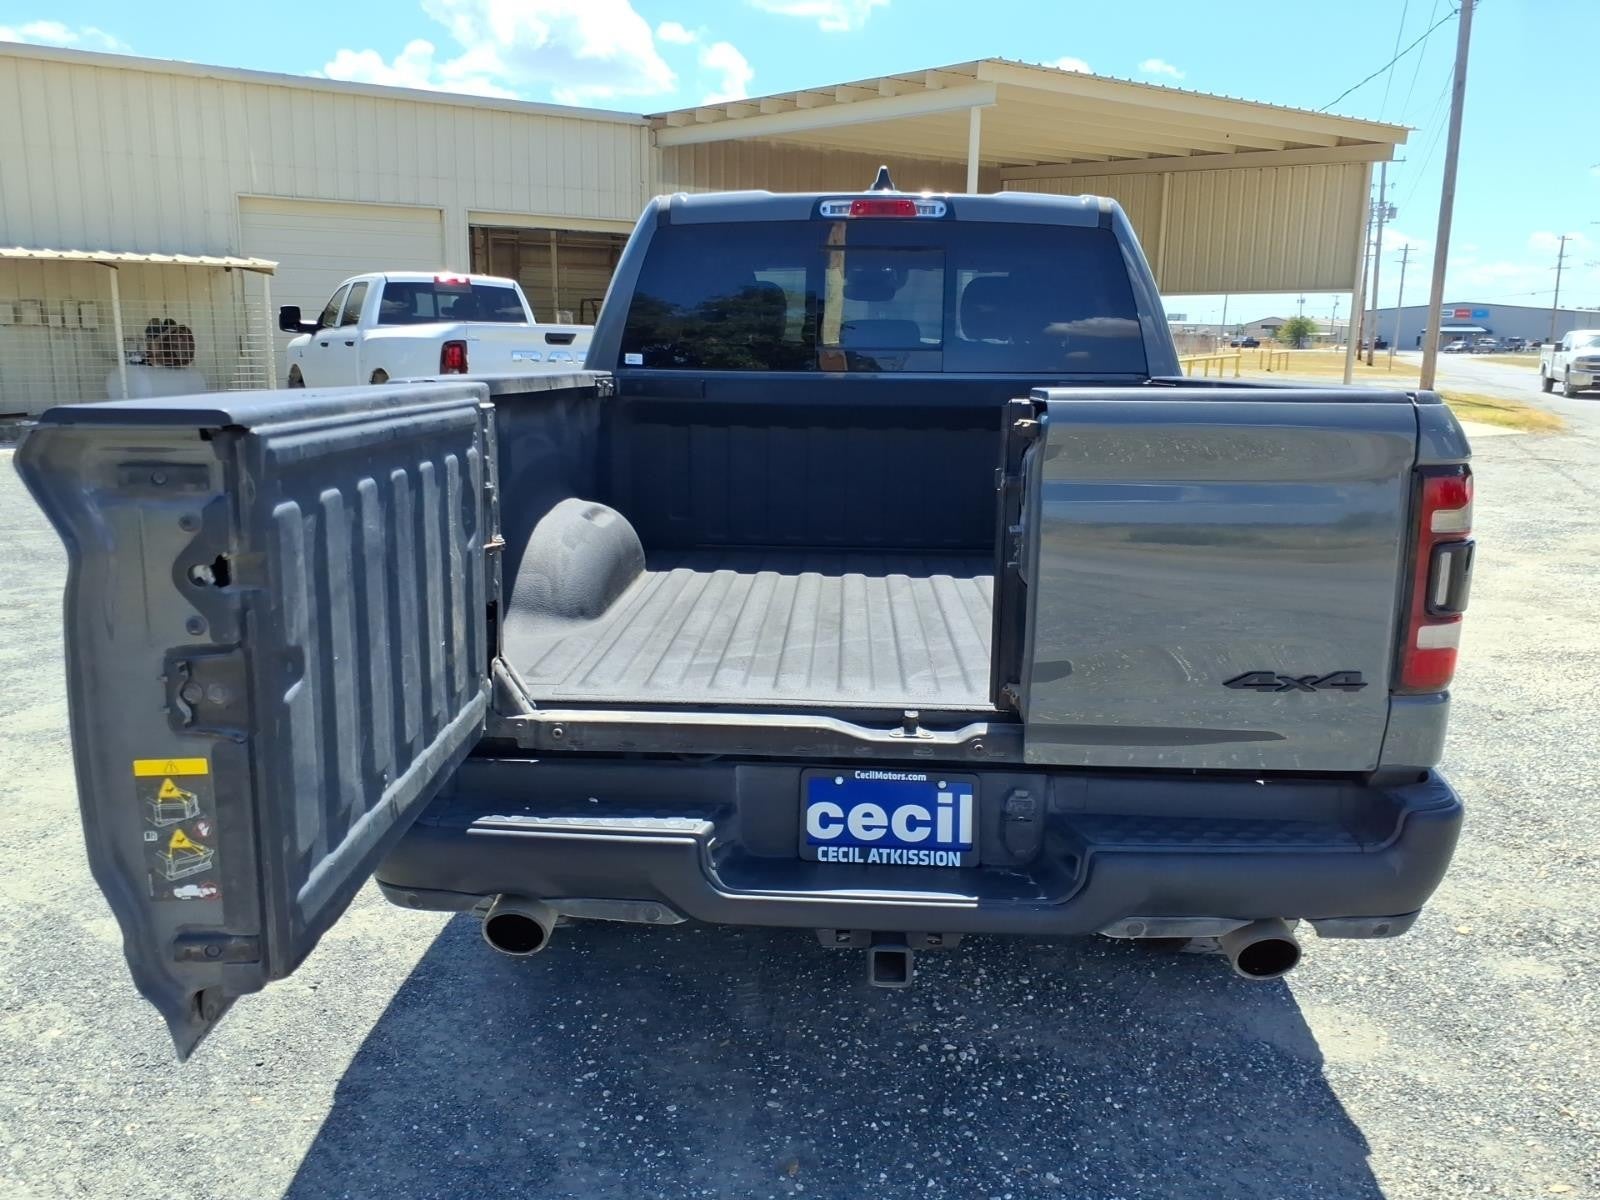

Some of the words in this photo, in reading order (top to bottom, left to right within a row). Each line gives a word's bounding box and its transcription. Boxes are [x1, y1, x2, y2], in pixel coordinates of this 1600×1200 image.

[854, 770, 927, 782] CecilMotors.com
[806, 792, 973, 844] cecil
[817, 846, 865, 864] CECIL
[867, 848, 961, 867] ATKISSION
